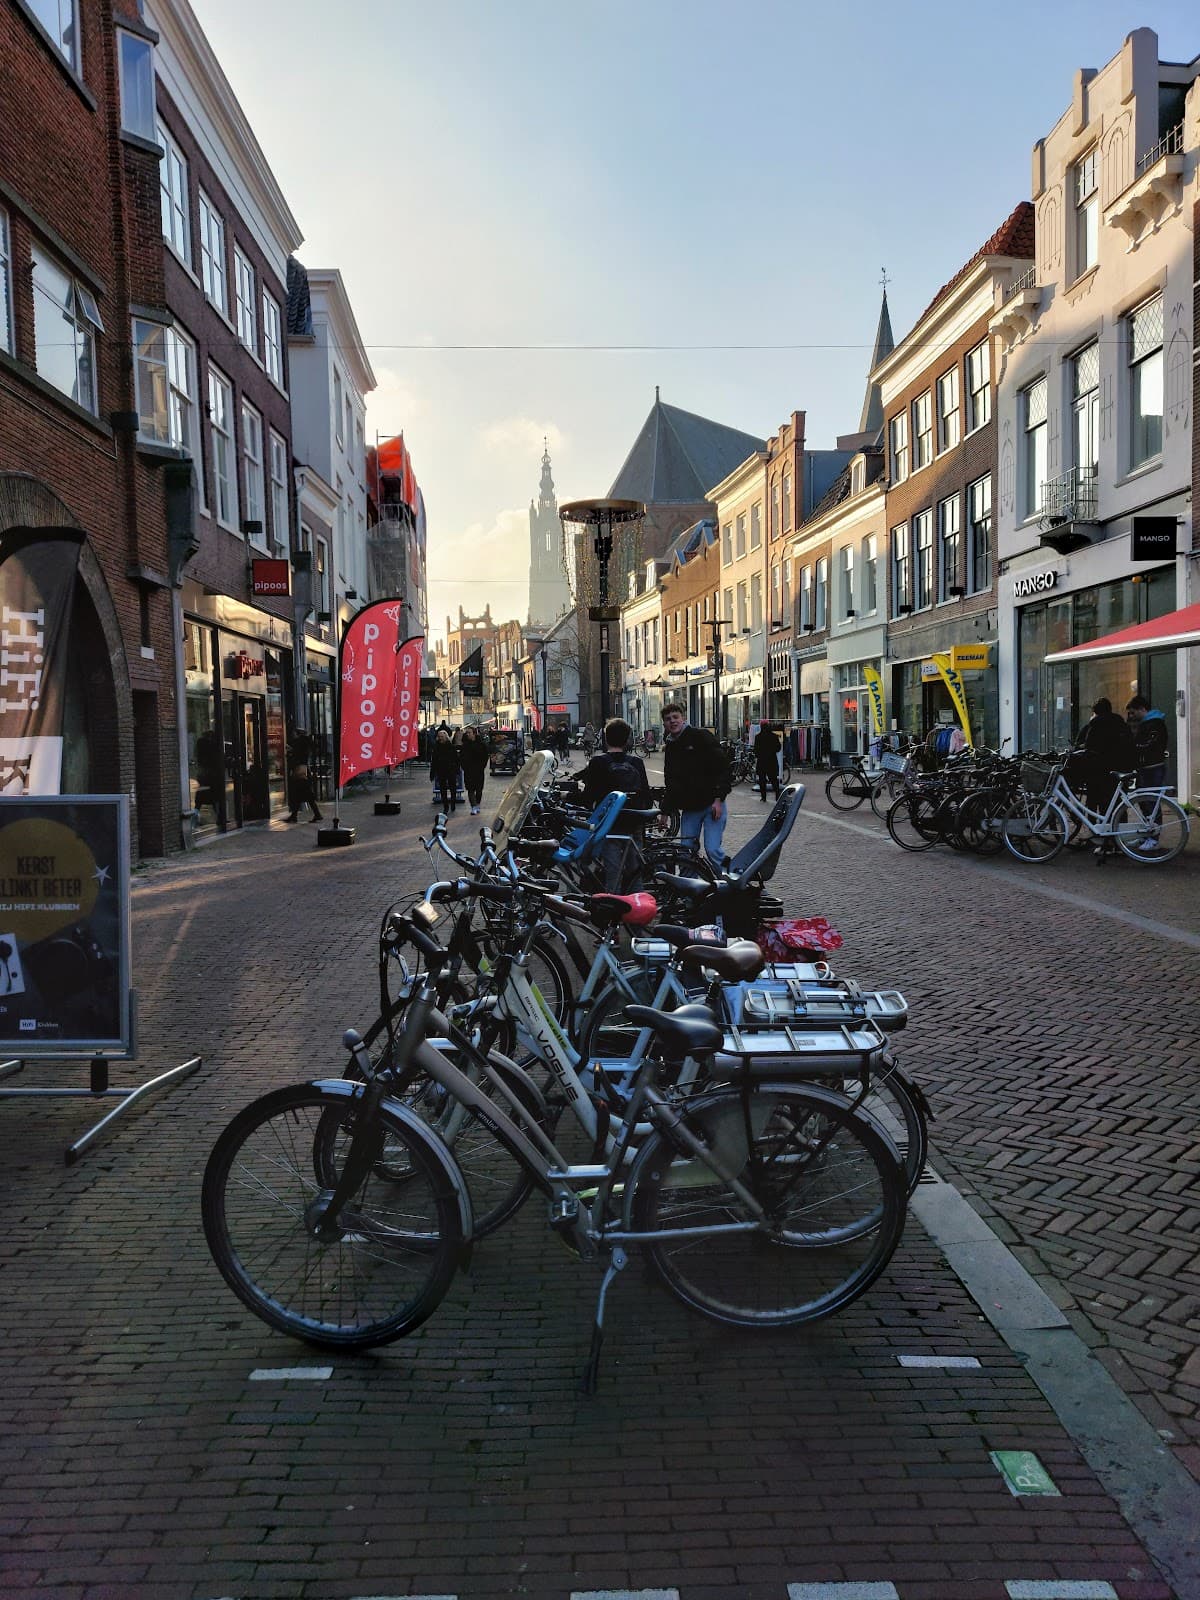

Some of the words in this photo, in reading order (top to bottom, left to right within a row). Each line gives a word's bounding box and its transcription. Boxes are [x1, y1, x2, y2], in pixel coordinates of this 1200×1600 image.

[254, 581, 288, 591] pipoos
[1013, 571, 1056, 597] MANGO
[359, 623, 380, 760] pipoos
[400, 654, 412, 753] pipoos
[17, 856, 56, 876] KERST
[0, 879, 39, 897] LINKT
[43, 879, 82, 897] BETER
[537, 1029, 580, 1102] VOGUE
